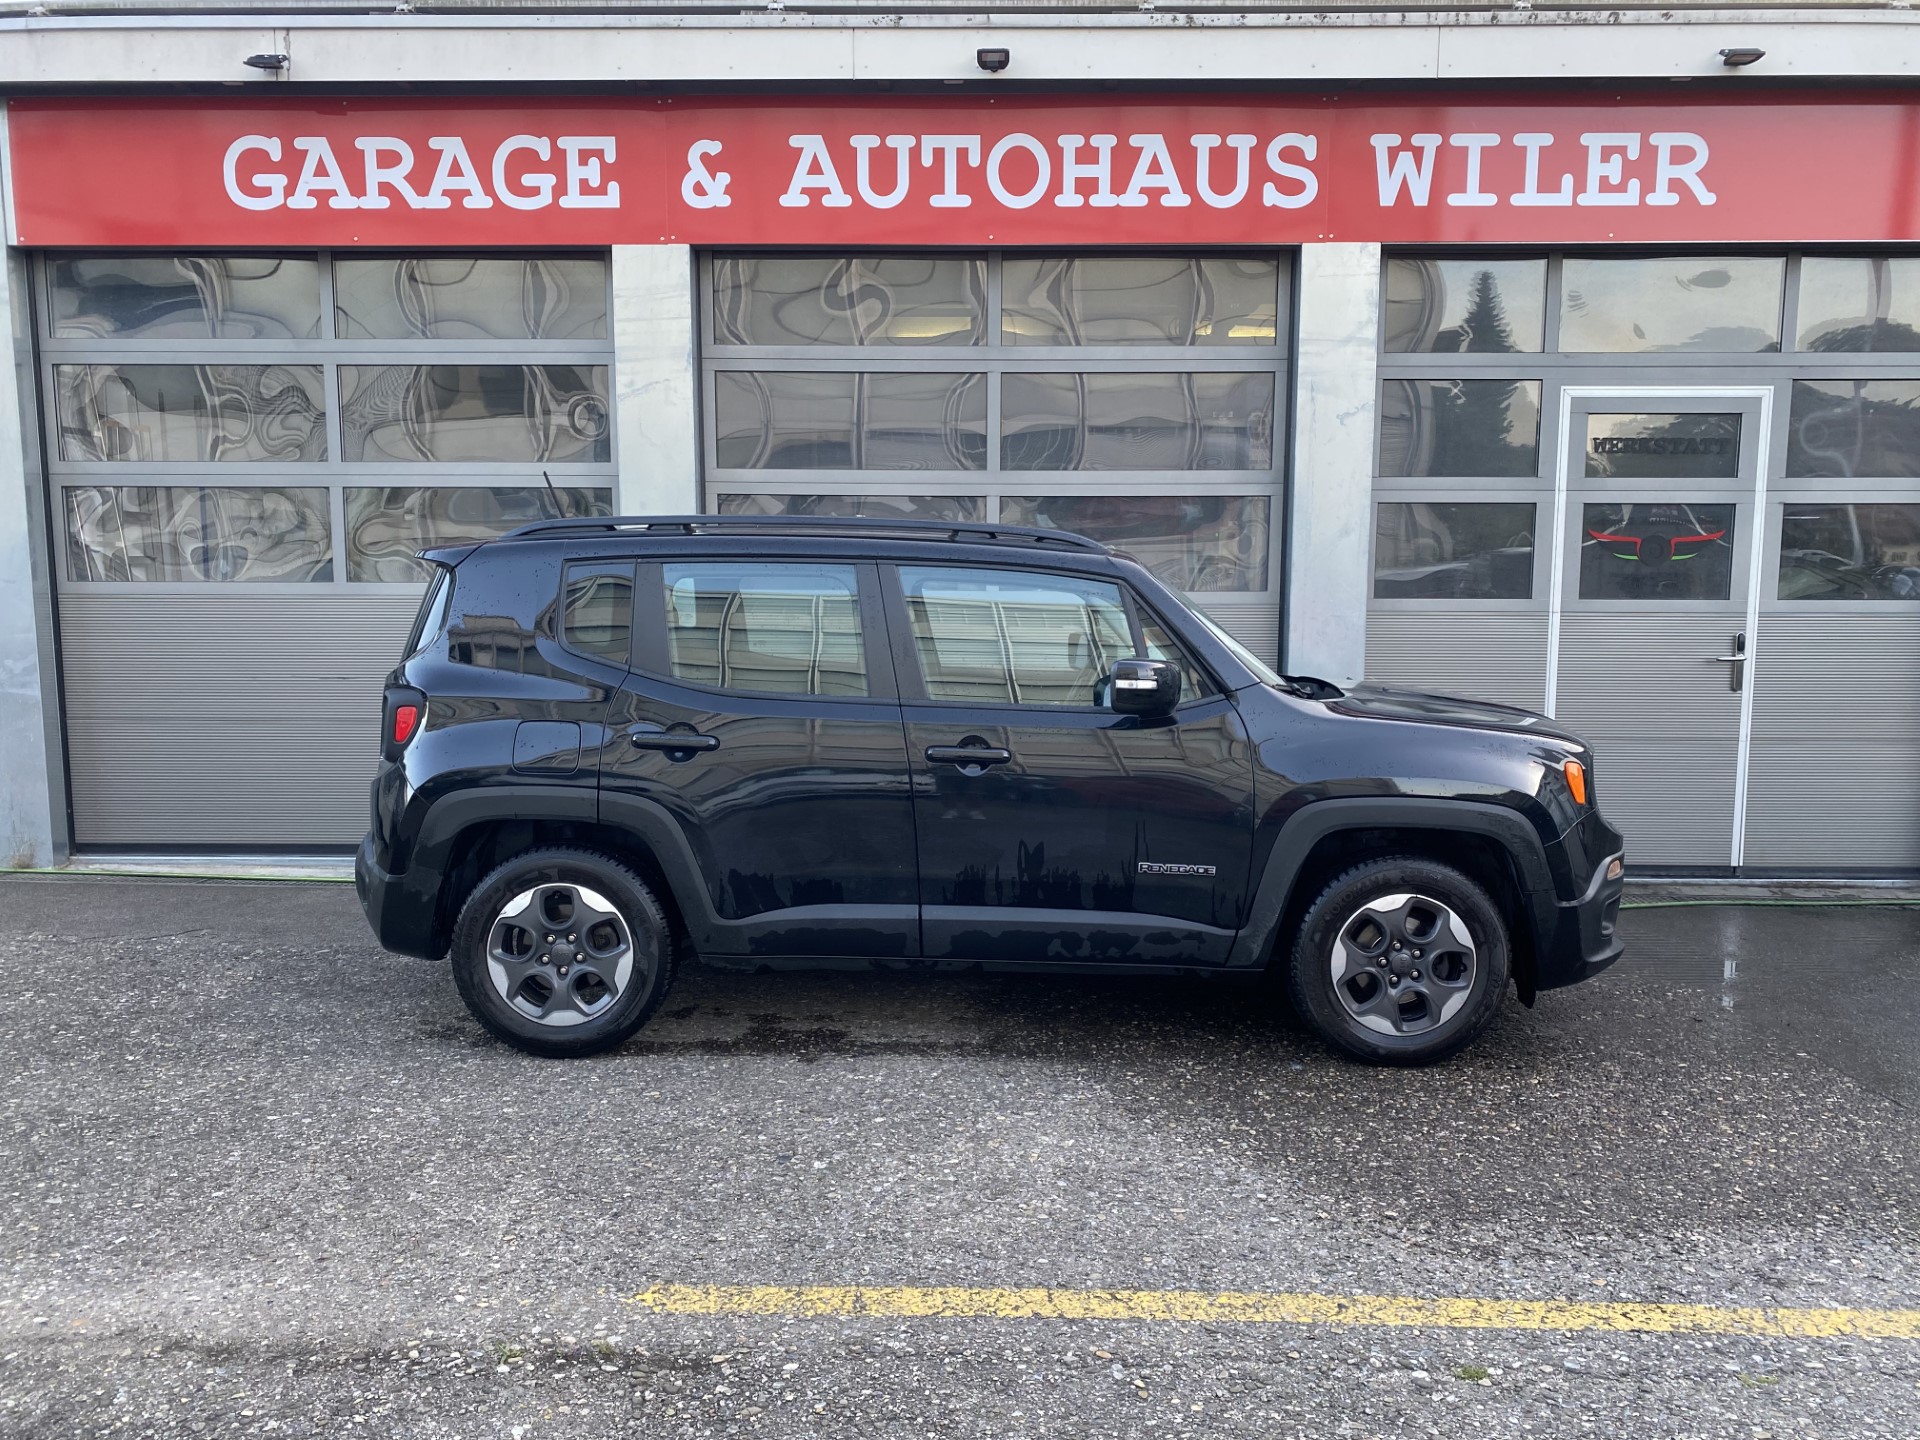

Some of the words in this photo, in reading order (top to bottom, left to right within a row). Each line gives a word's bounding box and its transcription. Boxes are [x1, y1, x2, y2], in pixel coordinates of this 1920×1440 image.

[222, 134, 621, 211] GARAGE
[681, 138, 732, 210] &
[778, 131, 1319, 210] AUTOHAUS
[1369, 131, 1718, 209] WILER
[1592, 437, 1733, 456] WERKSTATT
[1138, 862, 1217, 876] RENEGADE
